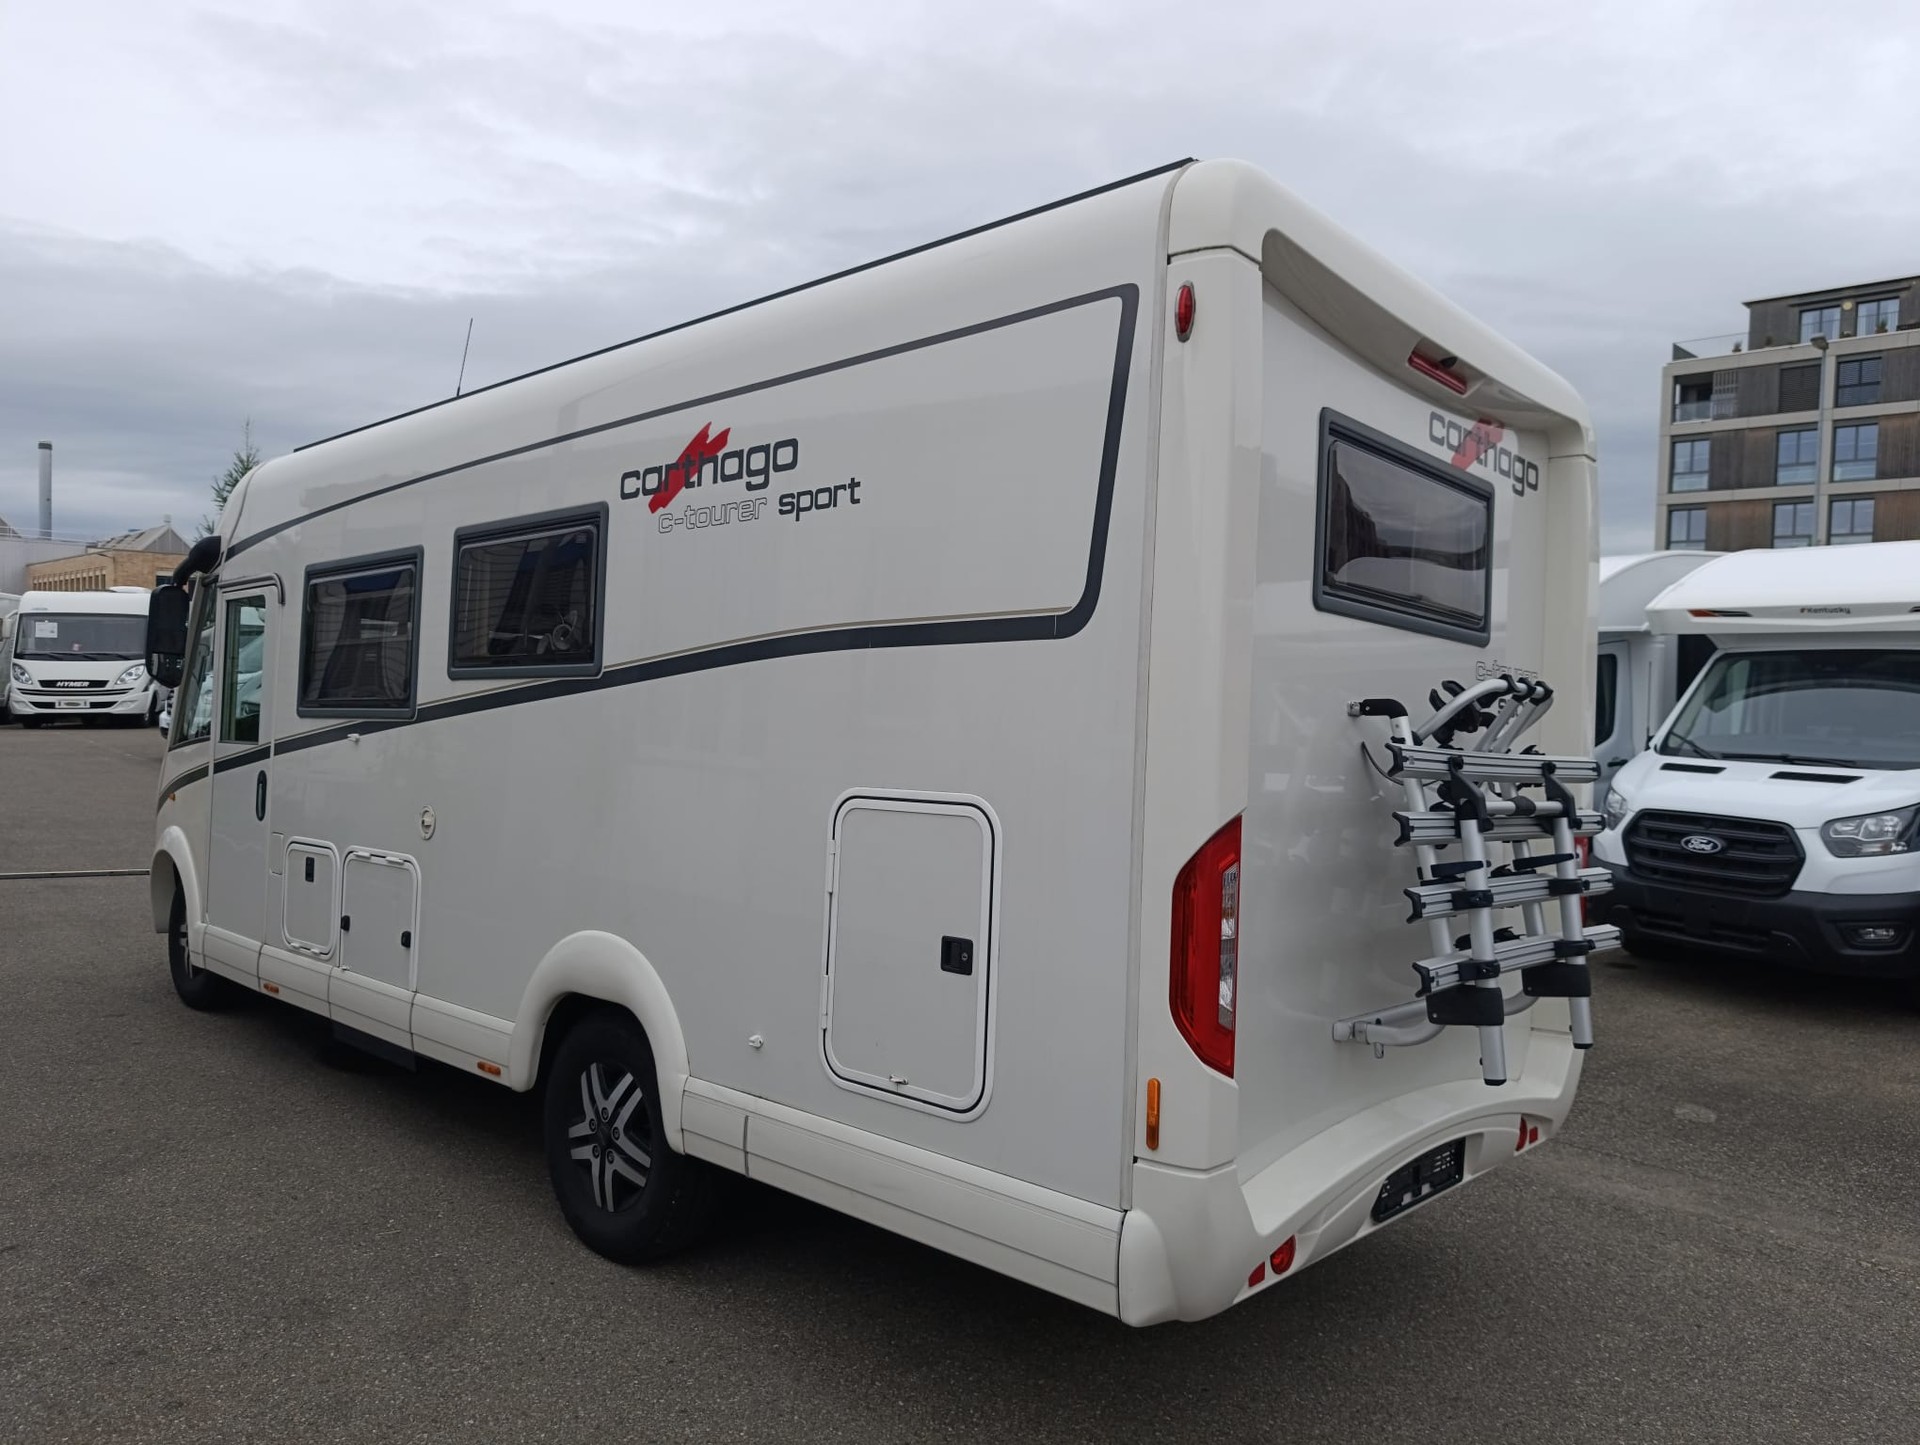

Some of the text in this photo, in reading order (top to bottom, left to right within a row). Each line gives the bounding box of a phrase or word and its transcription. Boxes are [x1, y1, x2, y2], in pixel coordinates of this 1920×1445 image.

[620, 438, 799, 500] carthago
[1429, 411, 1539, 497] carthago
[658, 477, 861, 534] c-tourer sport
[1688, 838, 1714, 850] Ford
